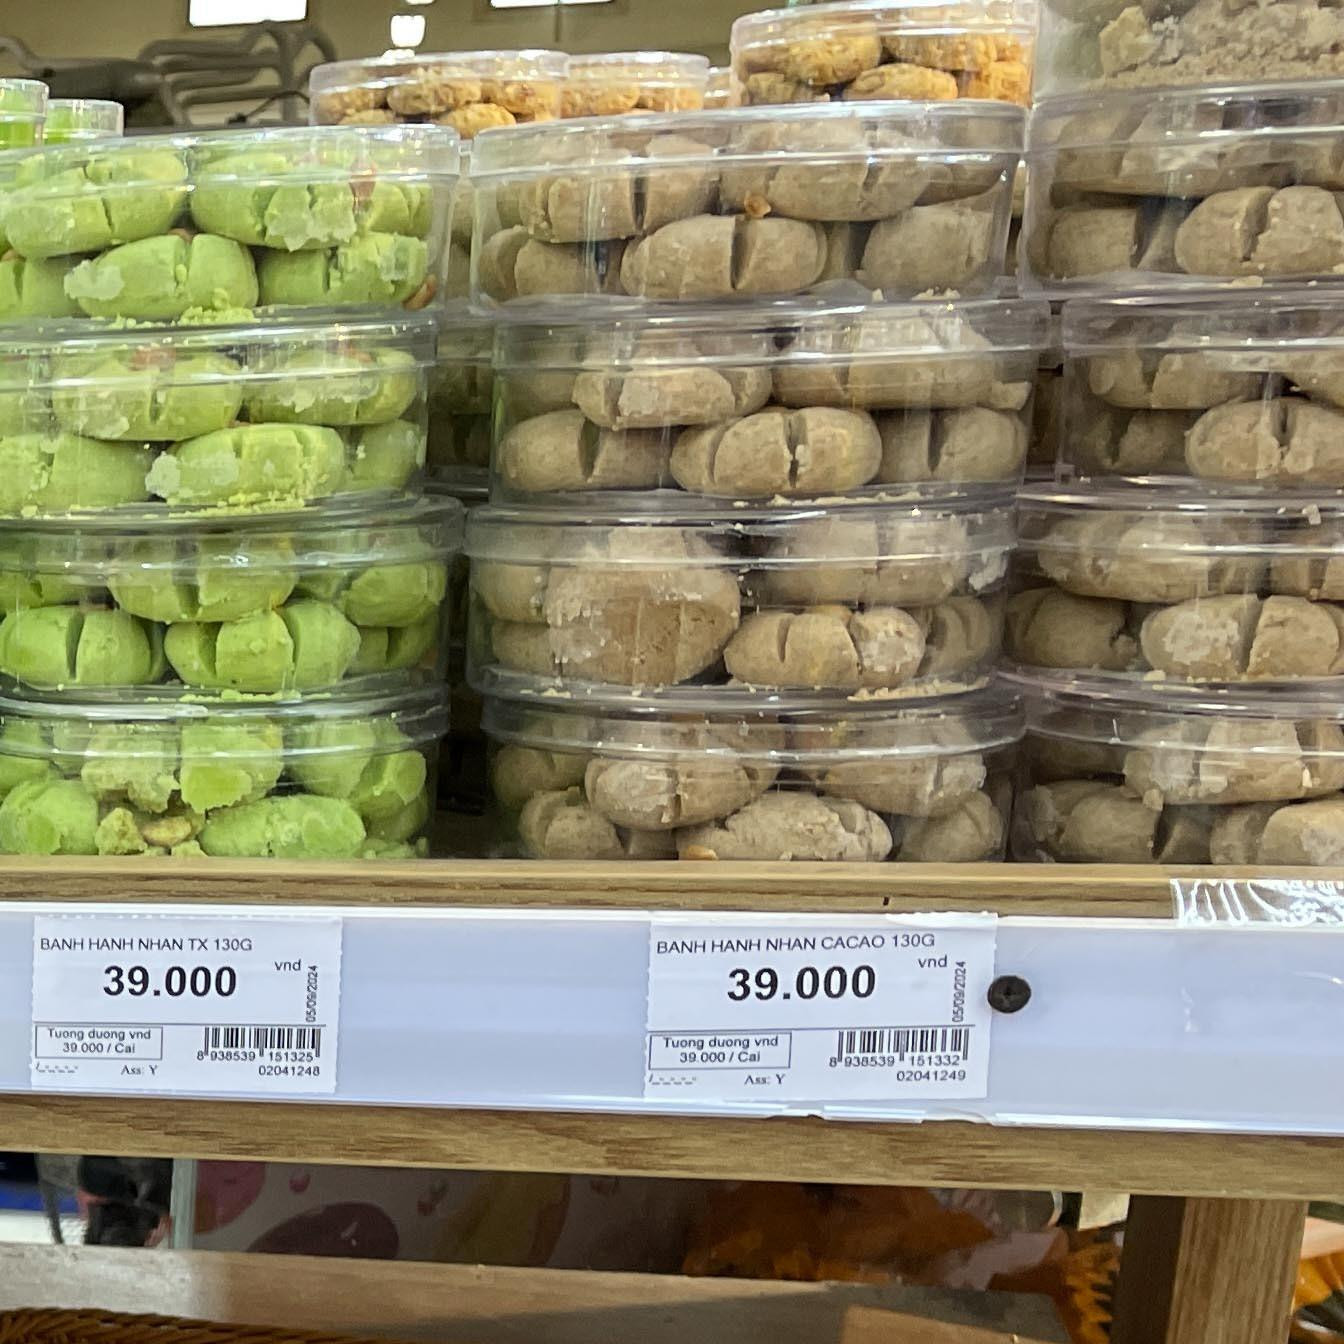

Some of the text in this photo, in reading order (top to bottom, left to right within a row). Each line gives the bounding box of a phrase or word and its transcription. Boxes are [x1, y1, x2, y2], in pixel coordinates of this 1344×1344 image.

[40, 938, 252, 951] BANH HANH NHAN TX 130G
[657, 933, 935, 954] BANH HANH NHAN CACAO 130G
[274, 959, 301, 972] vnd
[918, 955, 948, 968] vnd
[103, 965, 237, 997] 39.000
[727, 964, 876, 1002] 39.000
[952, 960, 966, 1022] 05/09/2024
[47, 1028, 151, 1041] Tuong duong vnd
[62, 1042, 104, 1053] 39.000
[114, 1043, 136, 1054] Cai
[663, 1036, 778, 1050] Tuong duong vnd
[210, 1051, 256, 1061] 938539
[269, 1051, 313, 1062] 151325
[680, 1051, 726, 1063] 39.000
[738, 1051, 761, 1063] Cai
[829, 1055, 960, 1067] 8 938539 151332
[149, 1065, 158, 1075] Y
[258, 1065, 320, 1077] 02041248
[896, 1070, 966, 1082] 02041249
[744, 1074, 786, 1085] Ass: Y
